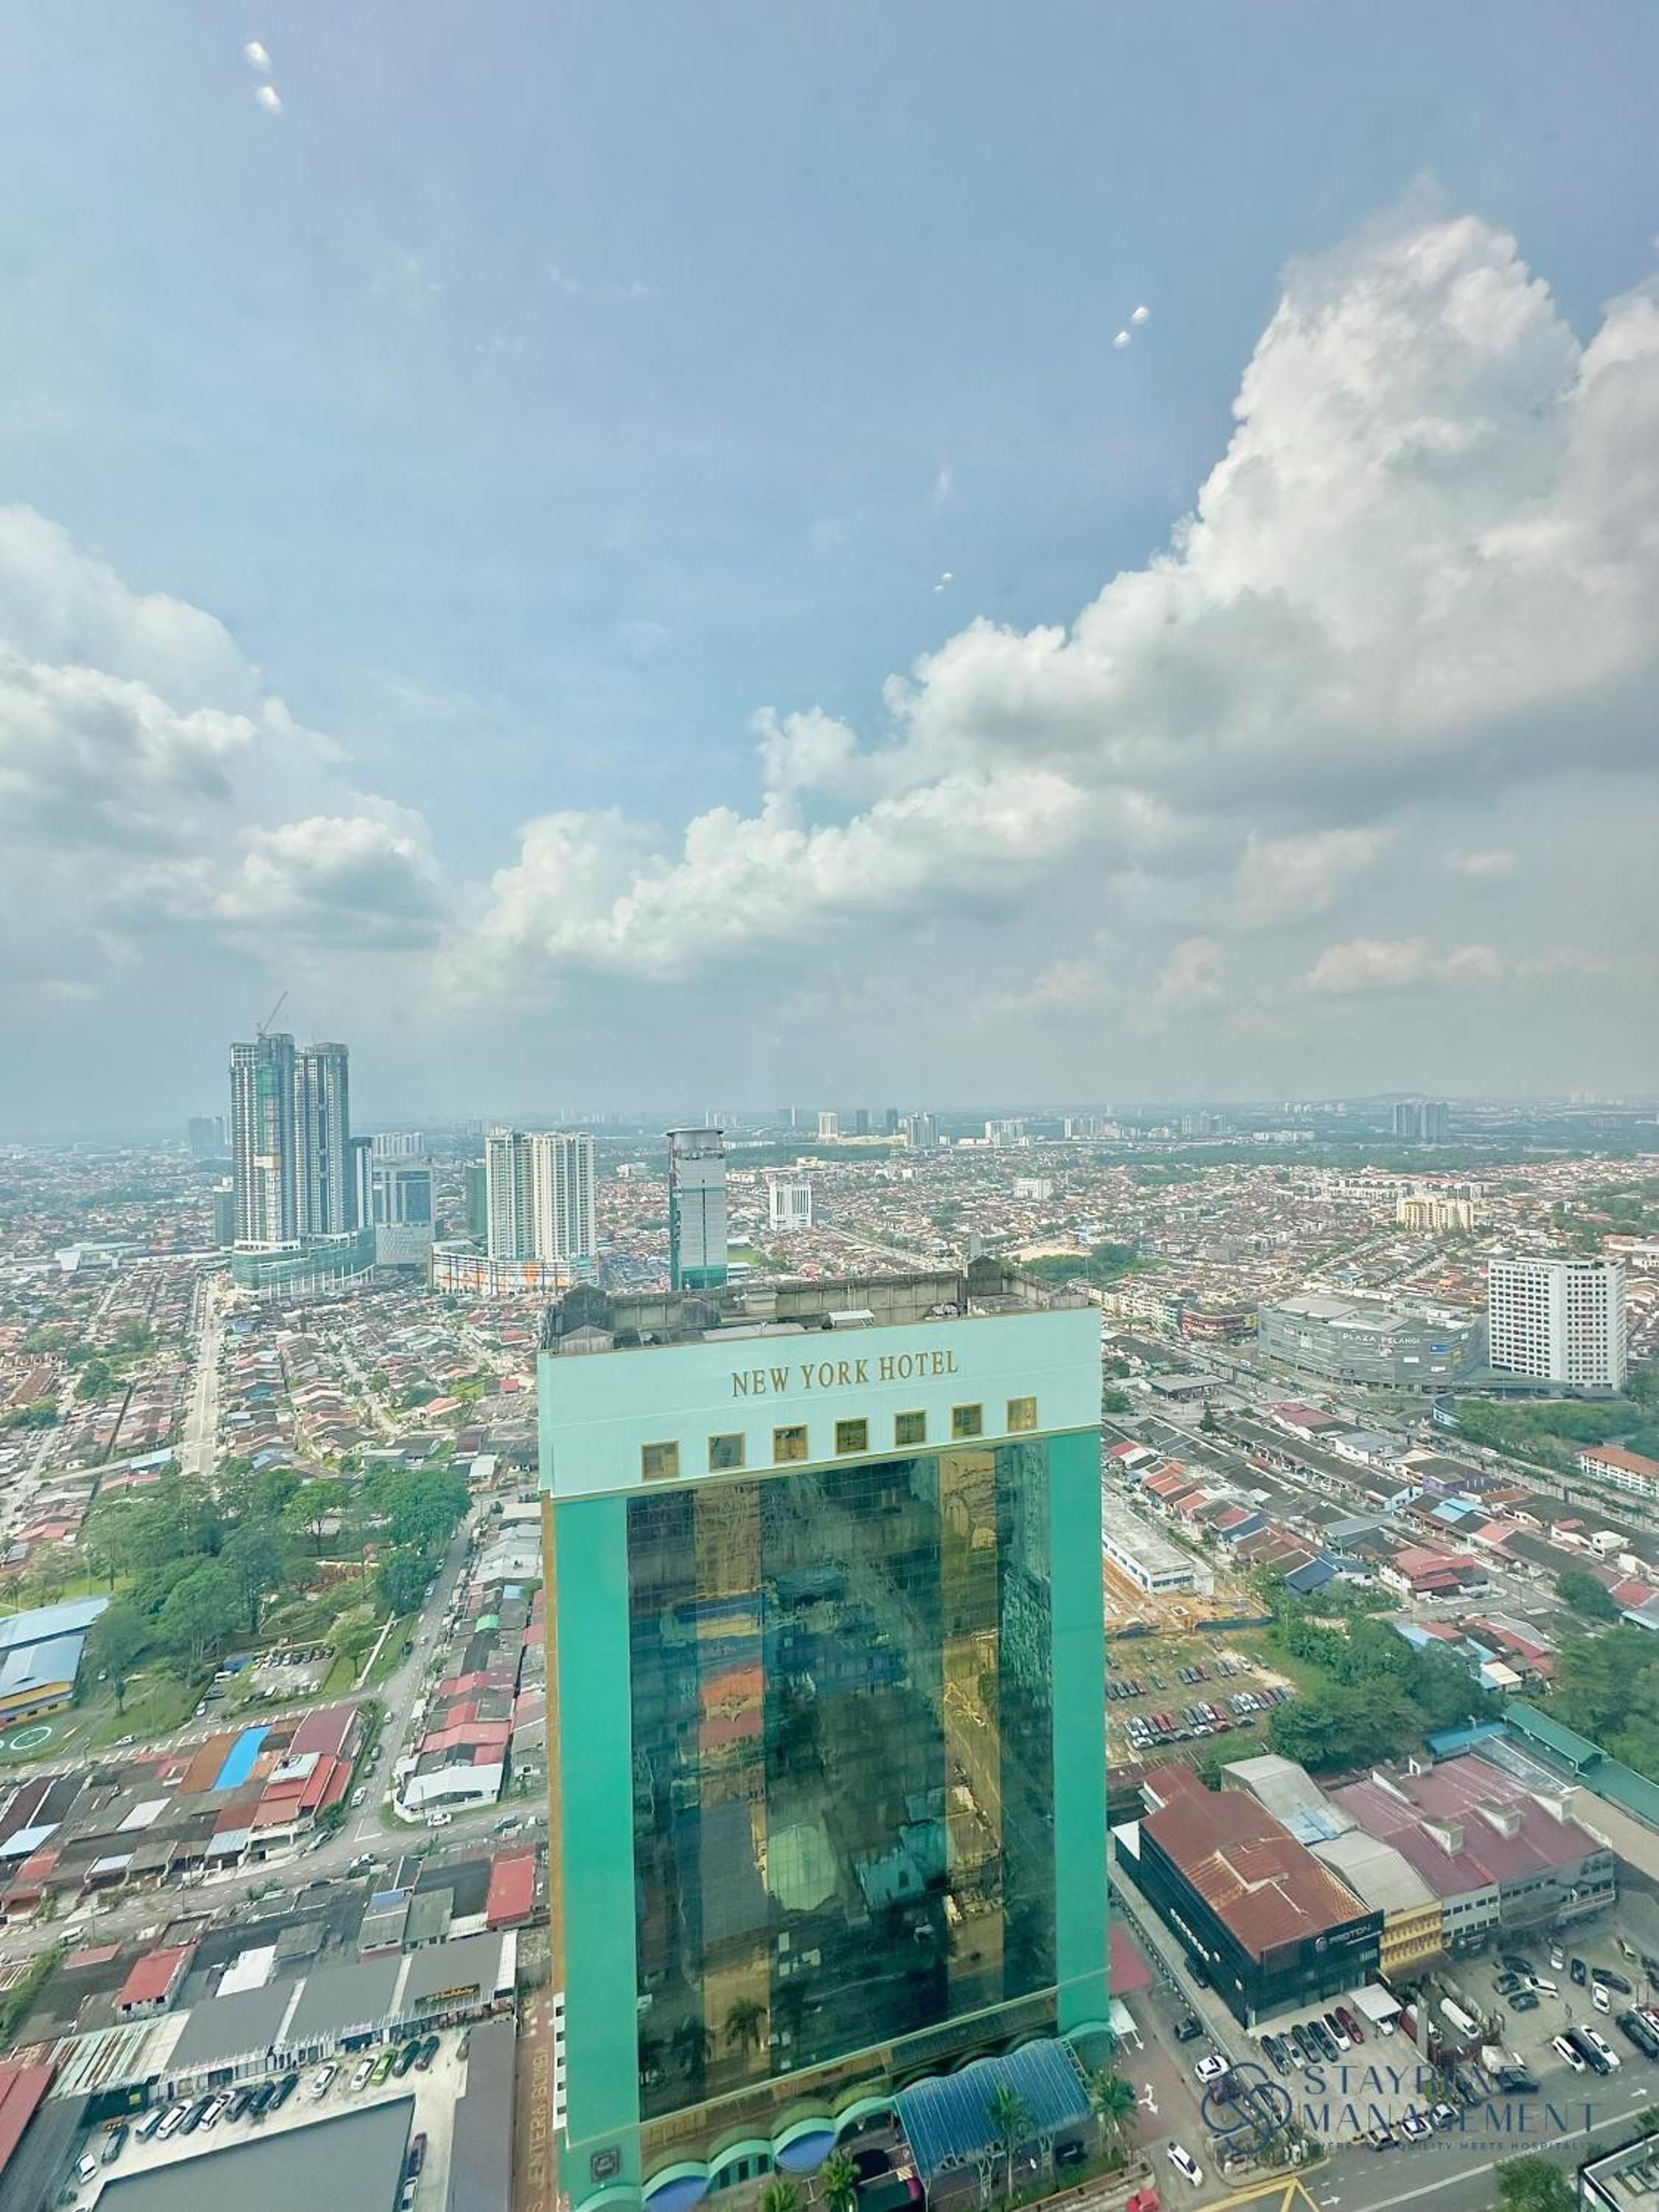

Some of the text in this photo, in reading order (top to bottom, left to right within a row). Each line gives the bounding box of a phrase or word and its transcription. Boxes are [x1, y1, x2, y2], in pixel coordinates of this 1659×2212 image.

[1343, 1332, 1377, 1342] PLAZA
[731, 1350, 959, 1397] NEW YORK HOTEL
